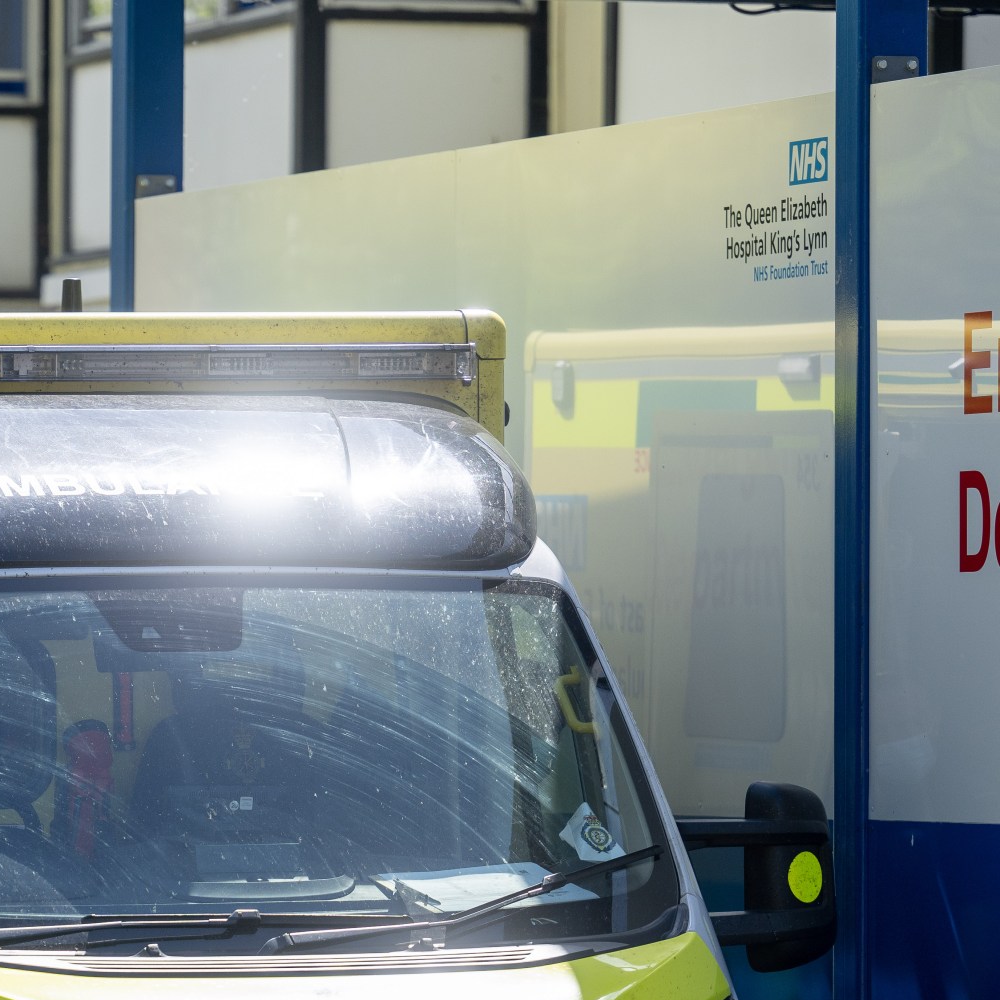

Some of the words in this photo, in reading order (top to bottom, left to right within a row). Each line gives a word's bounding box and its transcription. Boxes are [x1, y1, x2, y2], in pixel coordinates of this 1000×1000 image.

[790, 140, 827, 183] NHS
[724, 204, 742, 228] The
[745, 203, 777, 229] Queen
[781, 193, 828, 222] Elizabeth
[726, 232, 767, 263] Hospital
[770, 229, 800, 259] King's
[803, 228, 828, 257] Lynn
[753, 266, 769, 282] NHS
[769, 261, 809, 281] Foundation
[811, 259, 828, 276] Trust
